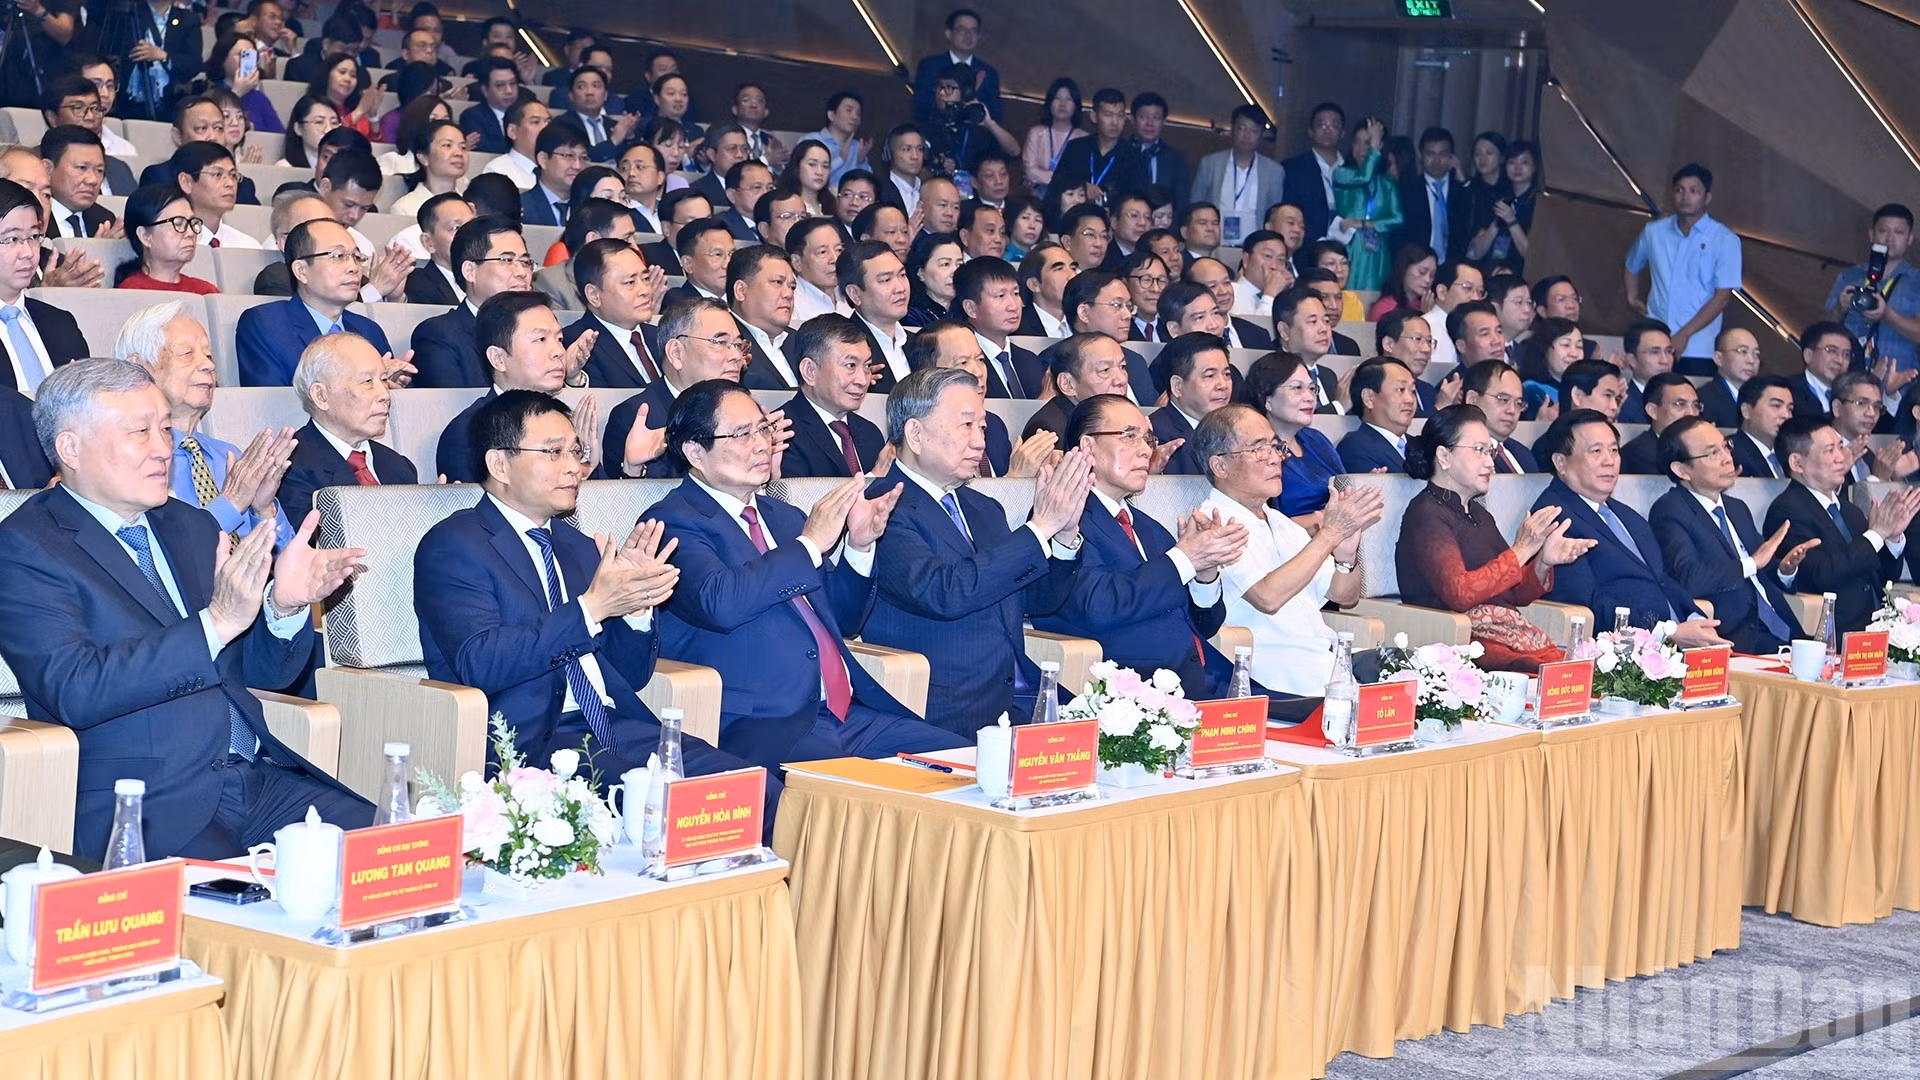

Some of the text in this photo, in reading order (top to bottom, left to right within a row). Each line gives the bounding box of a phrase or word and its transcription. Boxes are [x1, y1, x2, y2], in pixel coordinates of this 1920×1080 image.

[1406, 0, 1439, 9] EXIT
[1376, 707, 1395, 718] TÔ LÂM
[1201, 722, 1256, 739] PHẠM MINH CHÍNH
[1018, 747, 1091, 768] NGUYỄN VĂN THẮNG
[676, 805, 752, 829] NGUYỄN HÒA BÌNH
[351, 855, 450, 885] LƯƠNG TAM QUANG
[56, 910, 164, 944] TRẦN LƯU QUANG
